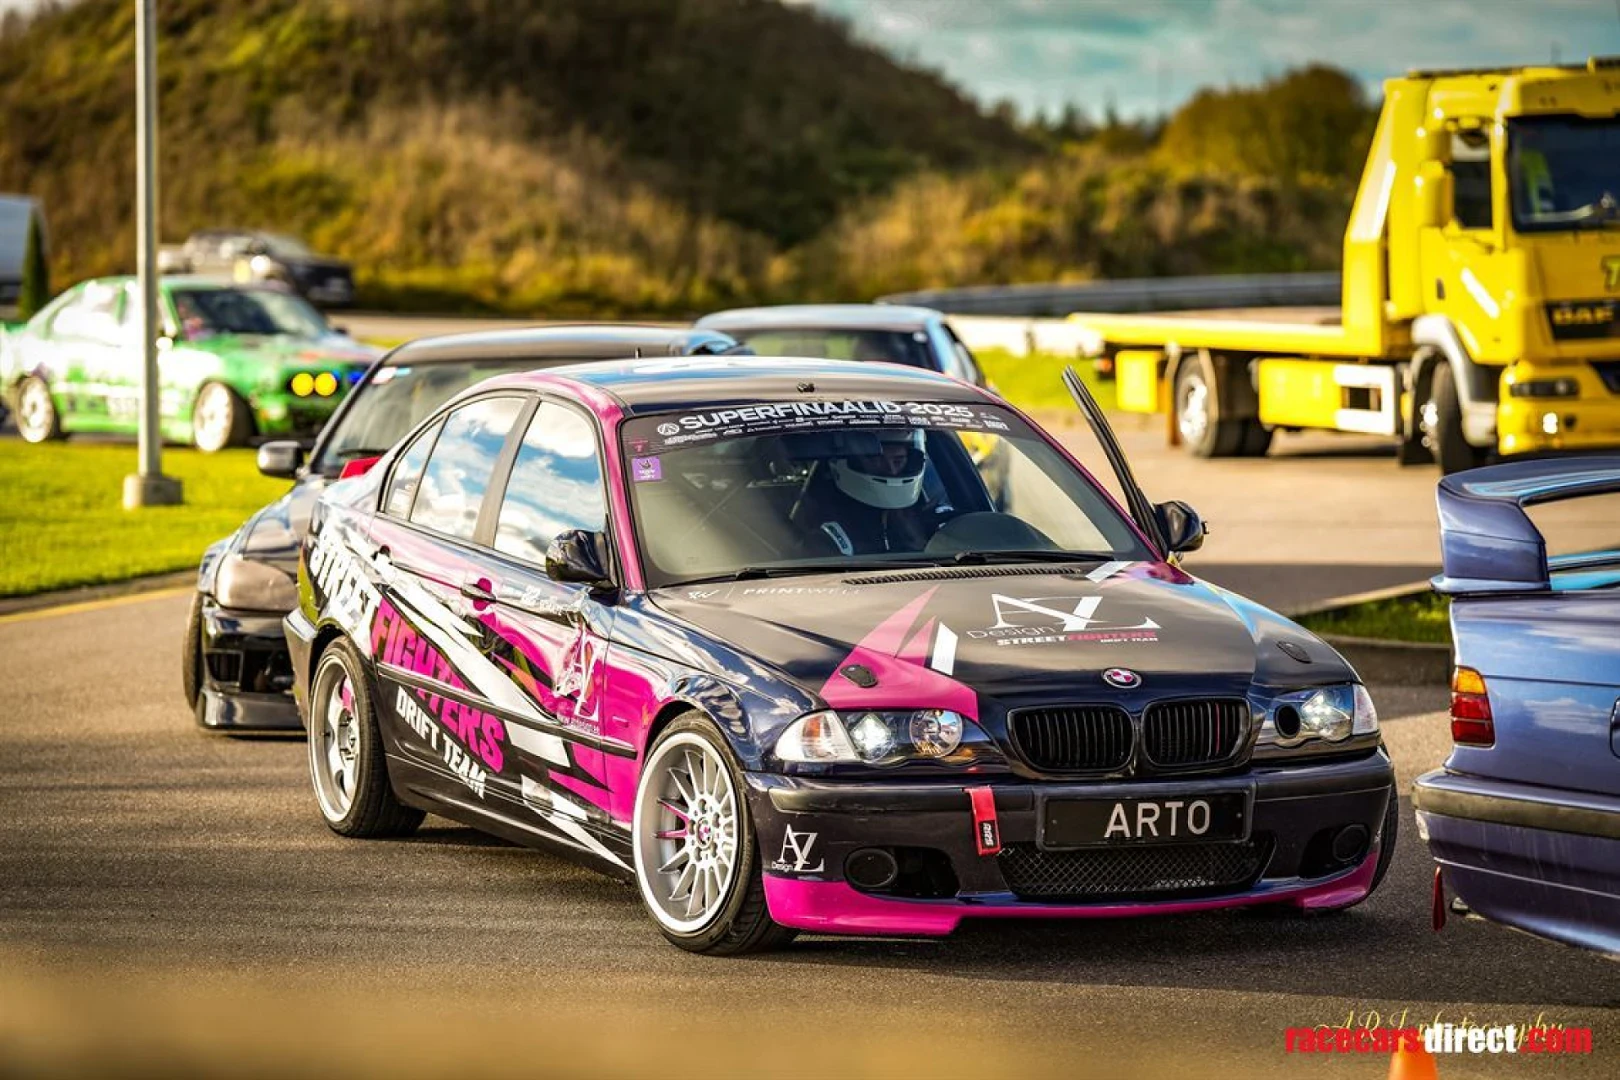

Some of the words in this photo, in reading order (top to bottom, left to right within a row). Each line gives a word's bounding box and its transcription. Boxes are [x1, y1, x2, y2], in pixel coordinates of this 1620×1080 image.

[679, 401, 902, 429] SUPERFINAALID
[905, 402, 975, 418] 2025
[966, 625, 1057, 640] Design
[396, 685, 439, 750] DRIFT
[442, 732, 487, 799] TEAM
[1104, 799, 1211, 839] ARTO
